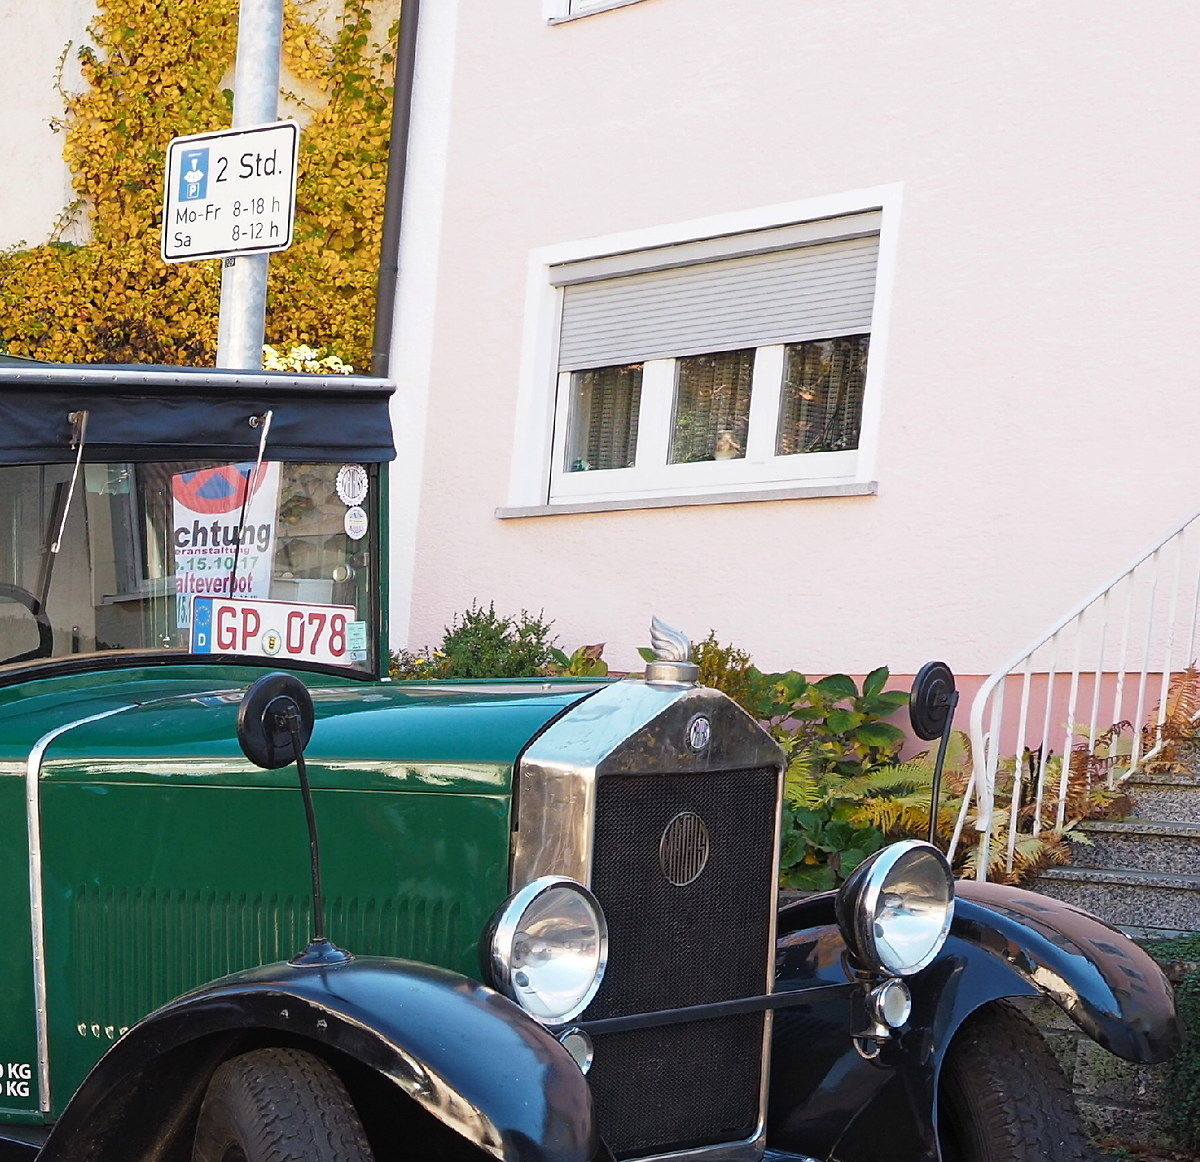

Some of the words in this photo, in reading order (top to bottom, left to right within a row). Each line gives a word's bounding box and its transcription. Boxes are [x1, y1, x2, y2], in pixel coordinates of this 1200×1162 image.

[215, 156, 229, 183] 2
[238, 149, 283, 180] Std.
[175, 203, 222, 225] Mo-Fr
[232, 197, 265, 217] 8-18
[271, 196, 280, 213] h
[173, 232, 192, 248] Sa
[231, 222, 264, 242] 8-12
[269, 220, 279, 238] h
[174, 519, 271, 553] chtung
[175, 547, 250, 556] eranstaltung
[176, 571, 253, 594] alteverbot
[197, 632, 207, 646] D
[216, 605, 261, 651] GP
[286, 610, 347, 658] 078
[7, 1063, 32, 1080] KG
[6, 1080, 30, 1097] KG
